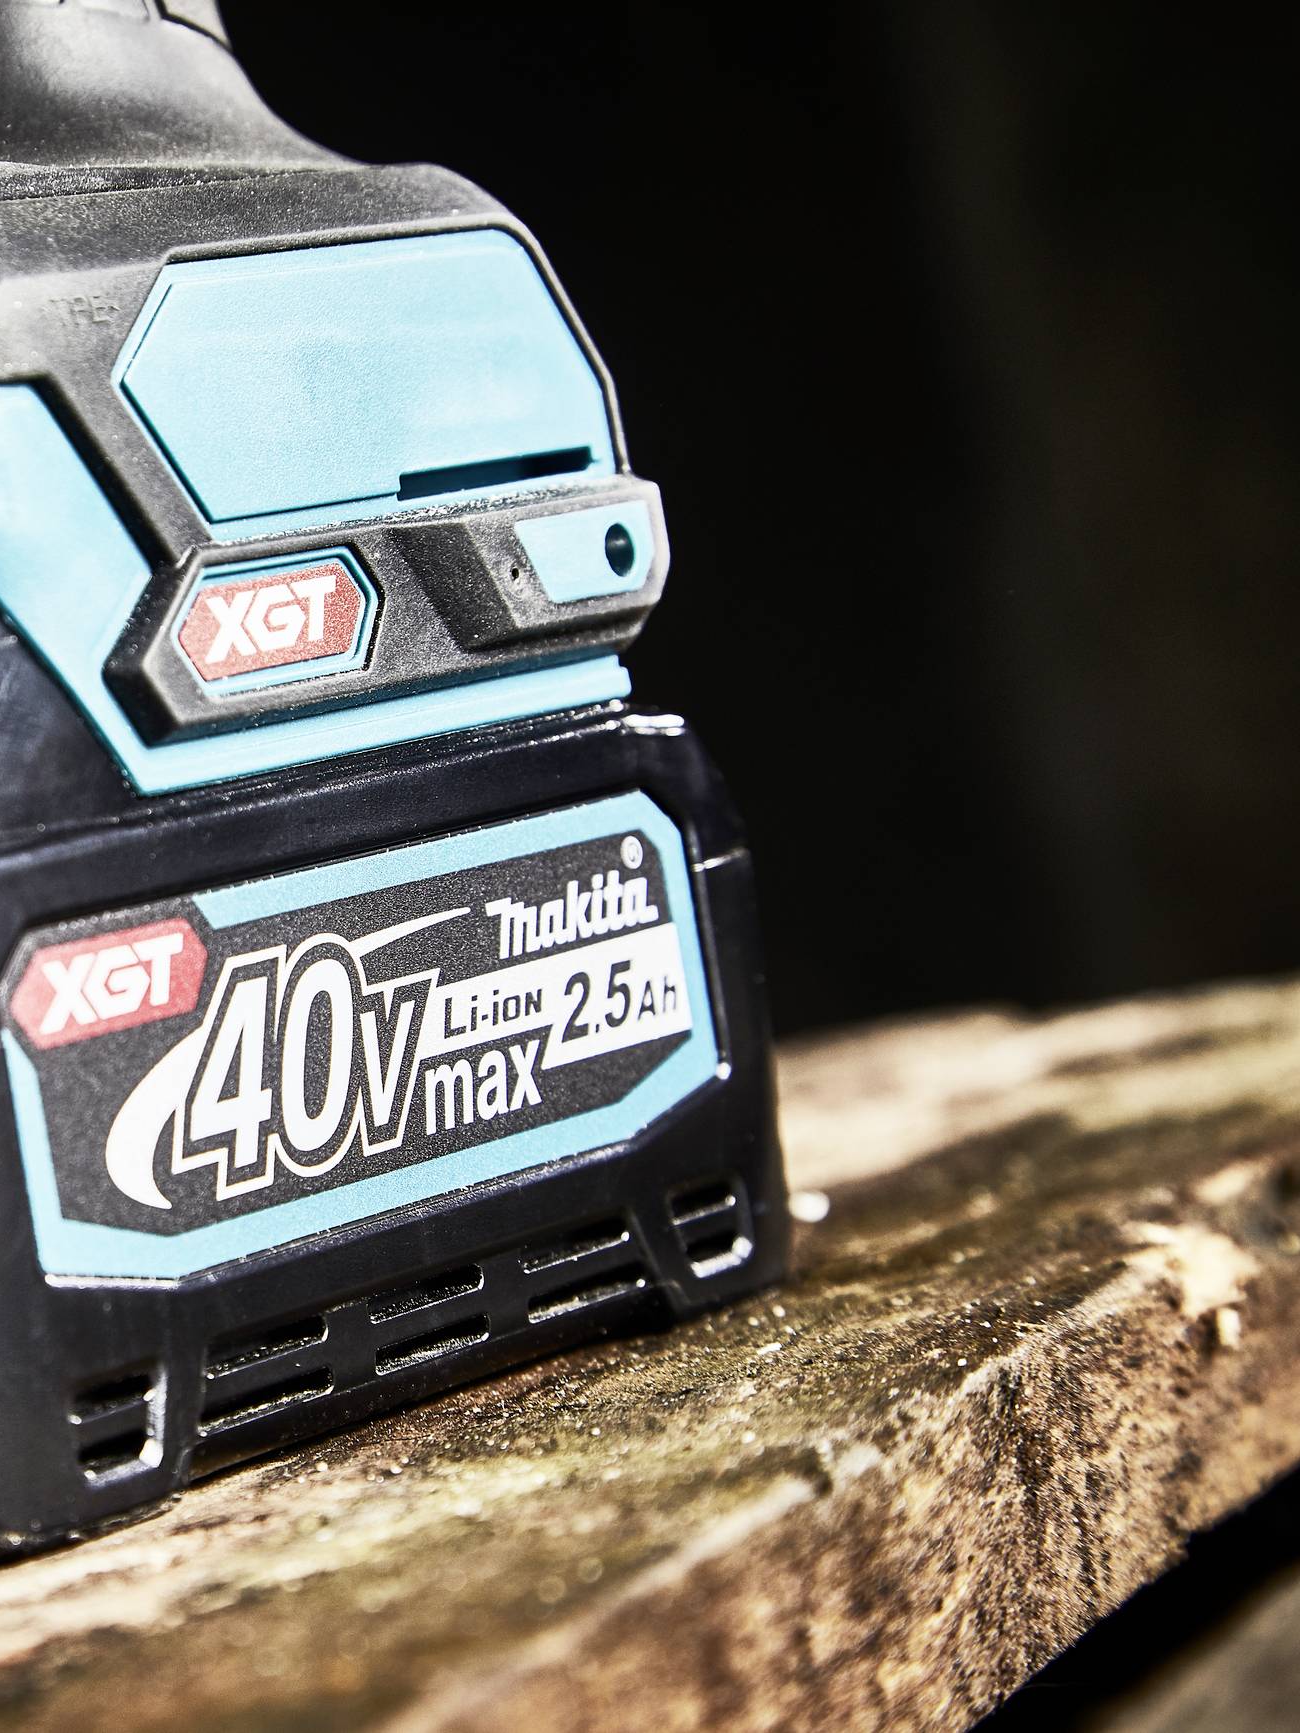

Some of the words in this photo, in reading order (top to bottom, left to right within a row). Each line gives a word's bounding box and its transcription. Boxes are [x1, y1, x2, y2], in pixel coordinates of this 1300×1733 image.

[204, 574, 337, 665] XGT
[38, 932, 185, 1036] XGT
[425, 1039, 543, 1137] max
